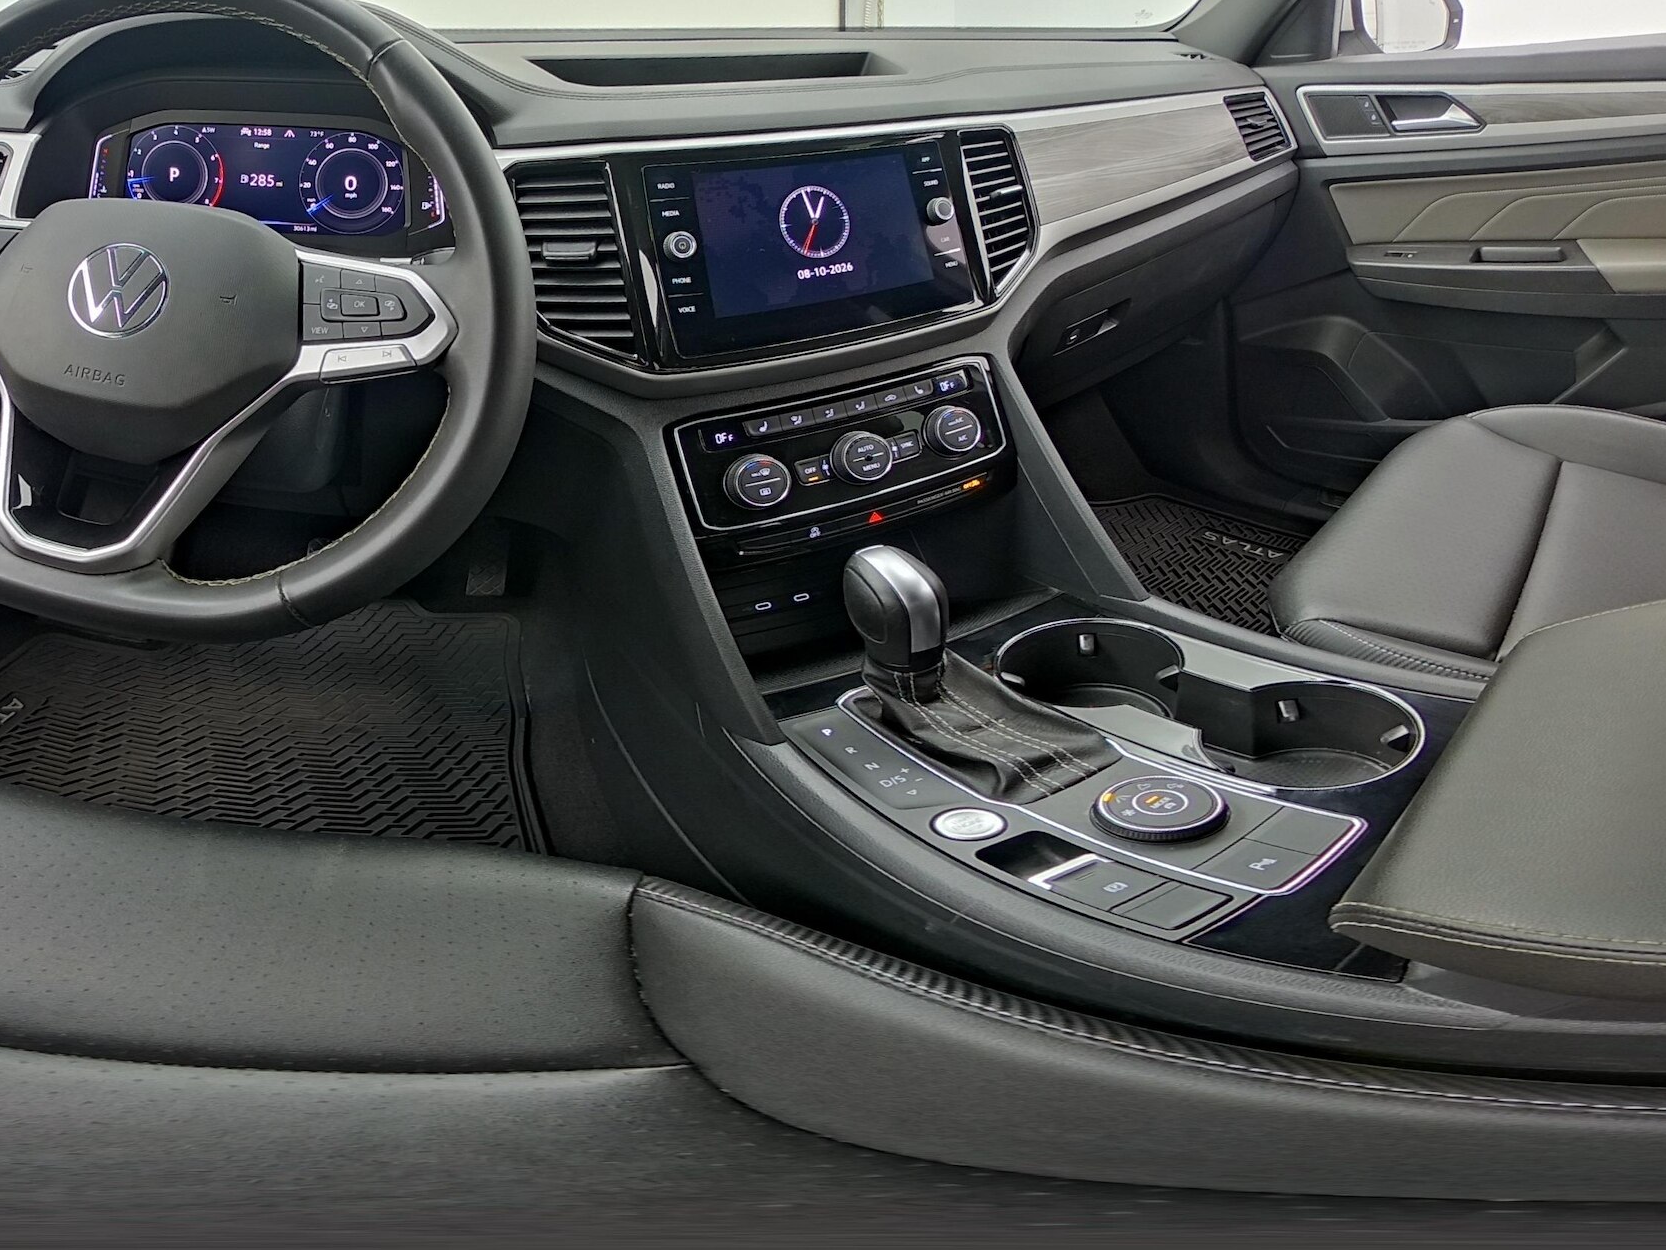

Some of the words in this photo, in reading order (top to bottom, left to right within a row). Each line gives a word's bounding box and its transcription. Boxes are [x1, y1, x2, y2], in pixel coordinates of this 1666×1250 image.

[253, 128, 273, 137] 12:58
[253, 141, 271, 150] Range
[169, 167, 181, 182] P
[249, 173, 276, 188] 285
[303, 181, 312, 189] 20
[344, 175, 358, 191] 0
[656, 182, 675, 190] RADIO
[344, 192, 358, 200] mph
[661, 209, 680, 217] MEDIA
[796, 261, 854, 280] 08-10-2026
[671, 276, 692, 285] PHONE
[353, 300, 366, 308] OK
[678, 305, 696, 313] VOICE
[311, 326, 330, 334] VIEW
[63, 363, 126, 388] AIRBAG
[857, 444, 875, 453] AUTO
[804, 466, 817, 475] OFF
[862, 462, 881, 472] MENU
[1202, 531, 1284, 559] ATLAS
[821, 728, 832, 736] P
[845, 746, 858, 754] R
[864, 762, 880, 770] N
[879, 775, 908, 788] D/S
